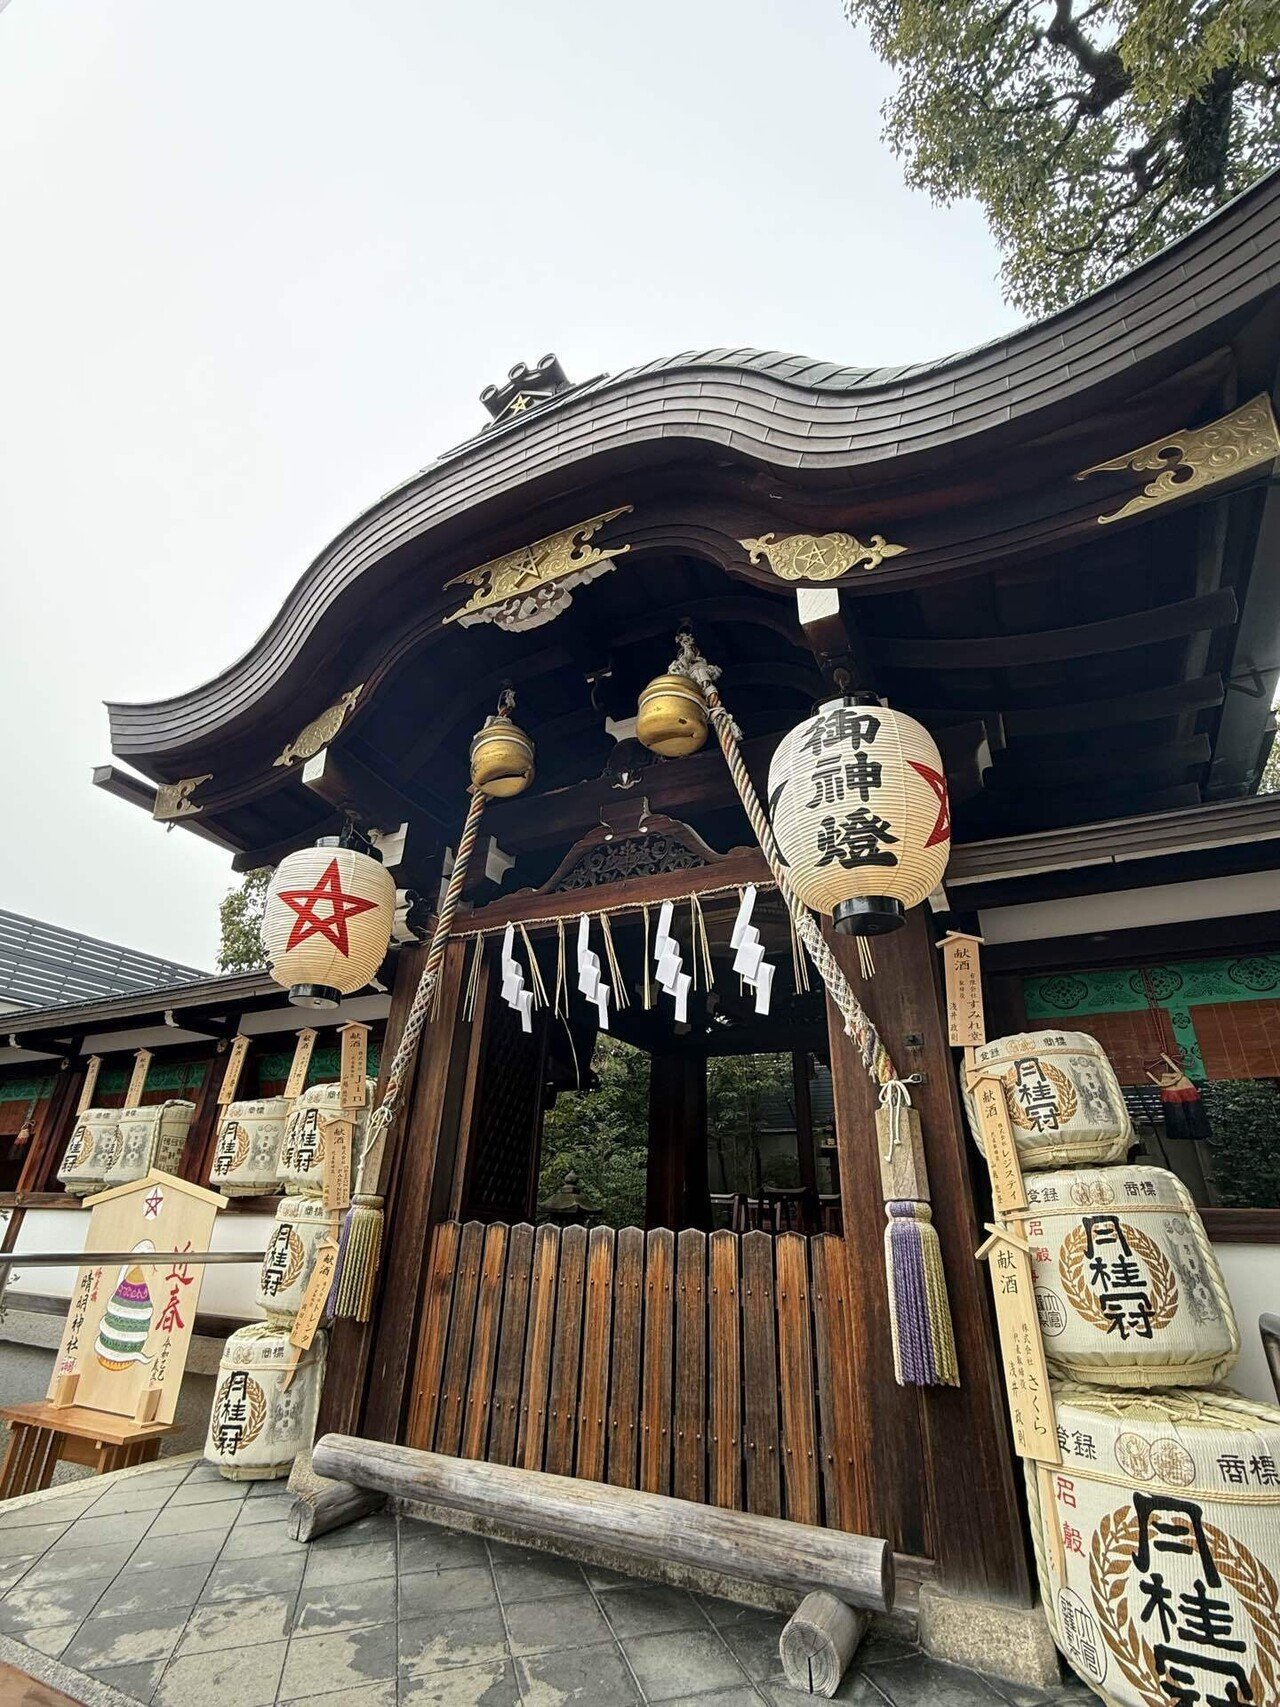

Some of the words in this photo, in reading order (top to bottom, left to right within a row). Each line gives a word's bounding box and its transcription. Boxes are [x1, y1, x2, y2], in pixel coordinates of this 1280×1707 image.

[799, 708, 901, 870] 御神燈
[953, 948, 972, 971] 献酒
[982, 1090, 998, 1119] 献酒
[1014, 1057, 1060, 1133] 月桂冠
[1027, 1187, 1060, 1204] 登録
[1124, 1181, 1157, 1197] 商標
[262, 1223, 293, 1297] 月桂冠
[997, 1250, 1018, 1294] 献酒
[1082, 1215, 1156, 1341] 月桂冠
[214, 1371, 249, 1456] 月桂冠
[1056, 1424, 1098, 1461] 登録
[1216, 1453, 1280, 1487] 商標
